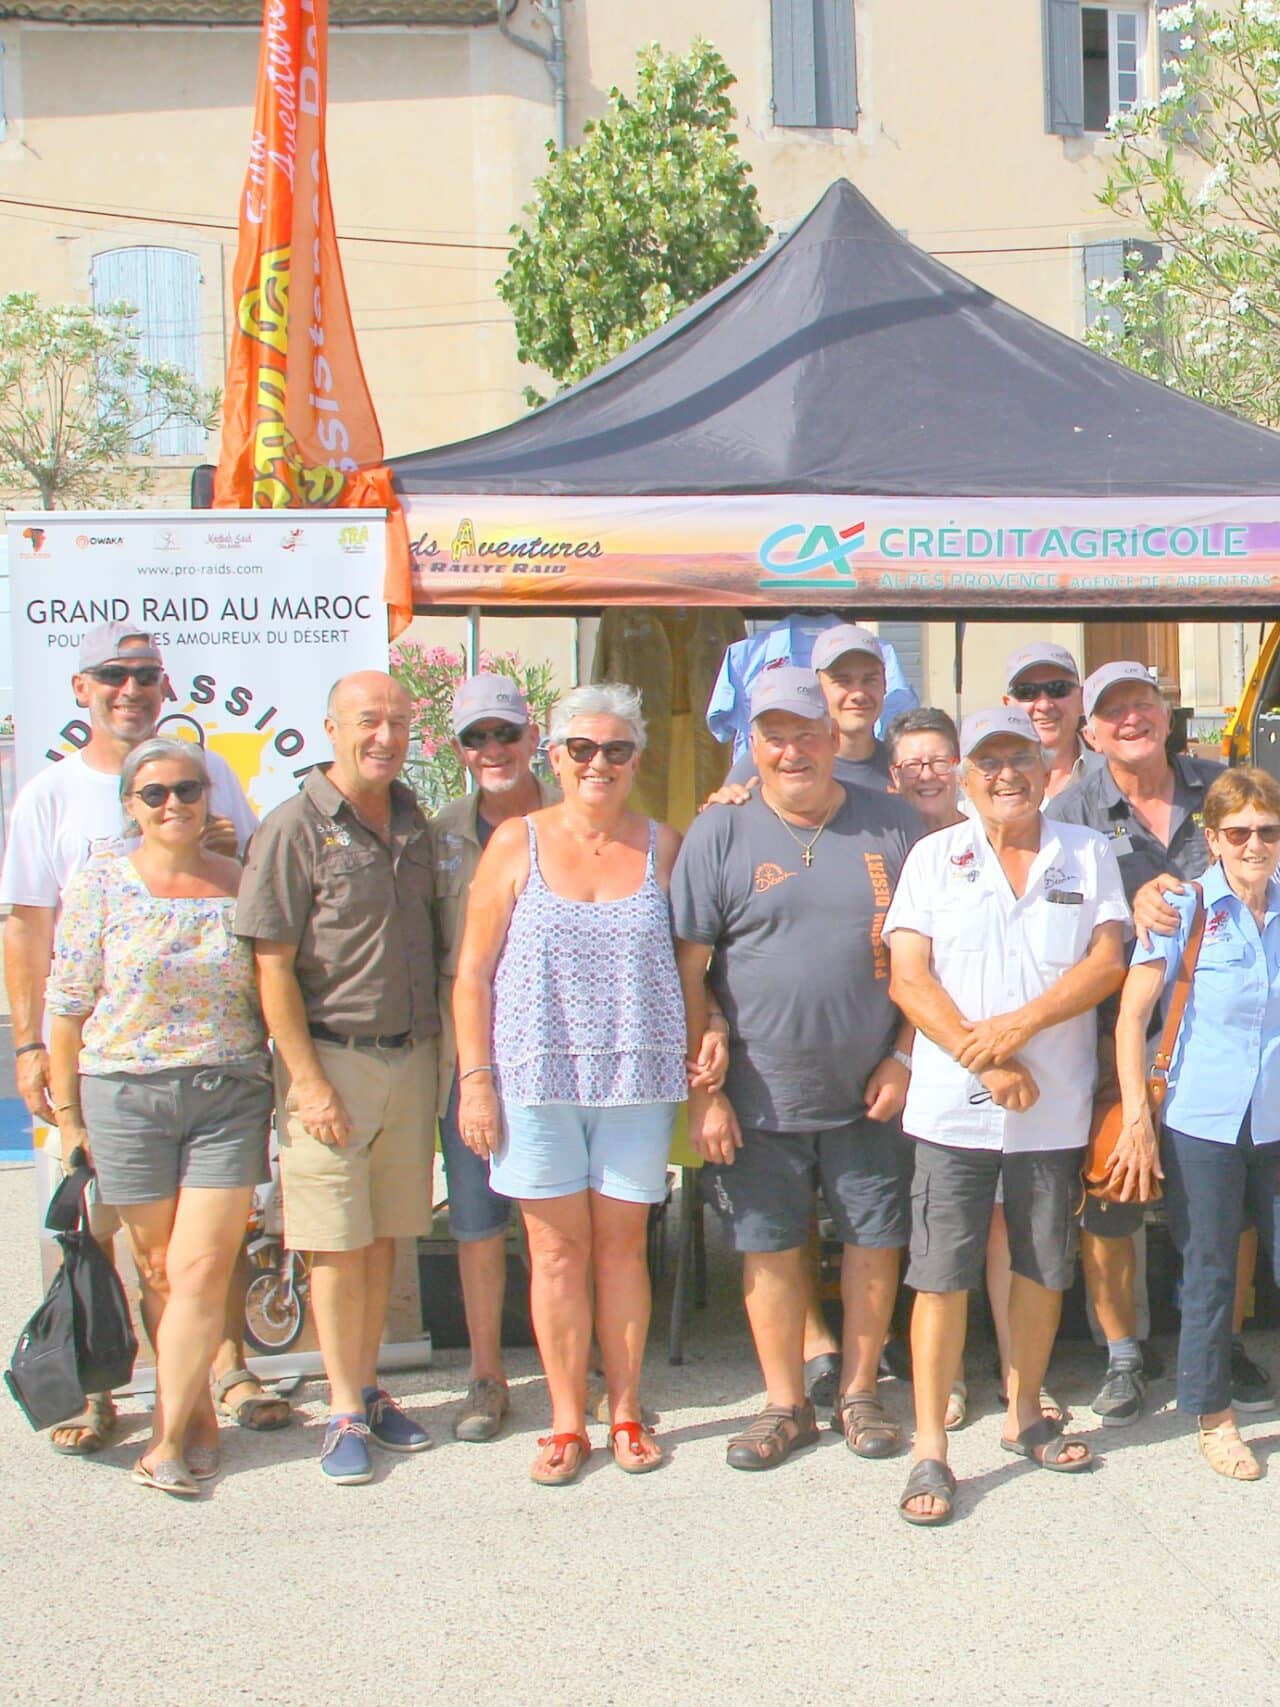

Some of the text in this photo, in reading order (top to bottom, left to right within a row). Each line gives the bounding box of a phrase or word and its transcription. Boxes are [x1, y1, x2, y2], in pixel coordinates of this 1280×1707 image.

[451, 518, 604, 562] Aventures
[879, 520, 1033, 558] CRÉDIT
[137, 564, 264, 576] www.pro-raids.com
[26, 595, 372, 625] GRAND RAID AU MAROC
[48, 634, 85, 648] POU
[176, 632, 262, 645] AMOUREUX
[267, 631, 289, 645] DU
